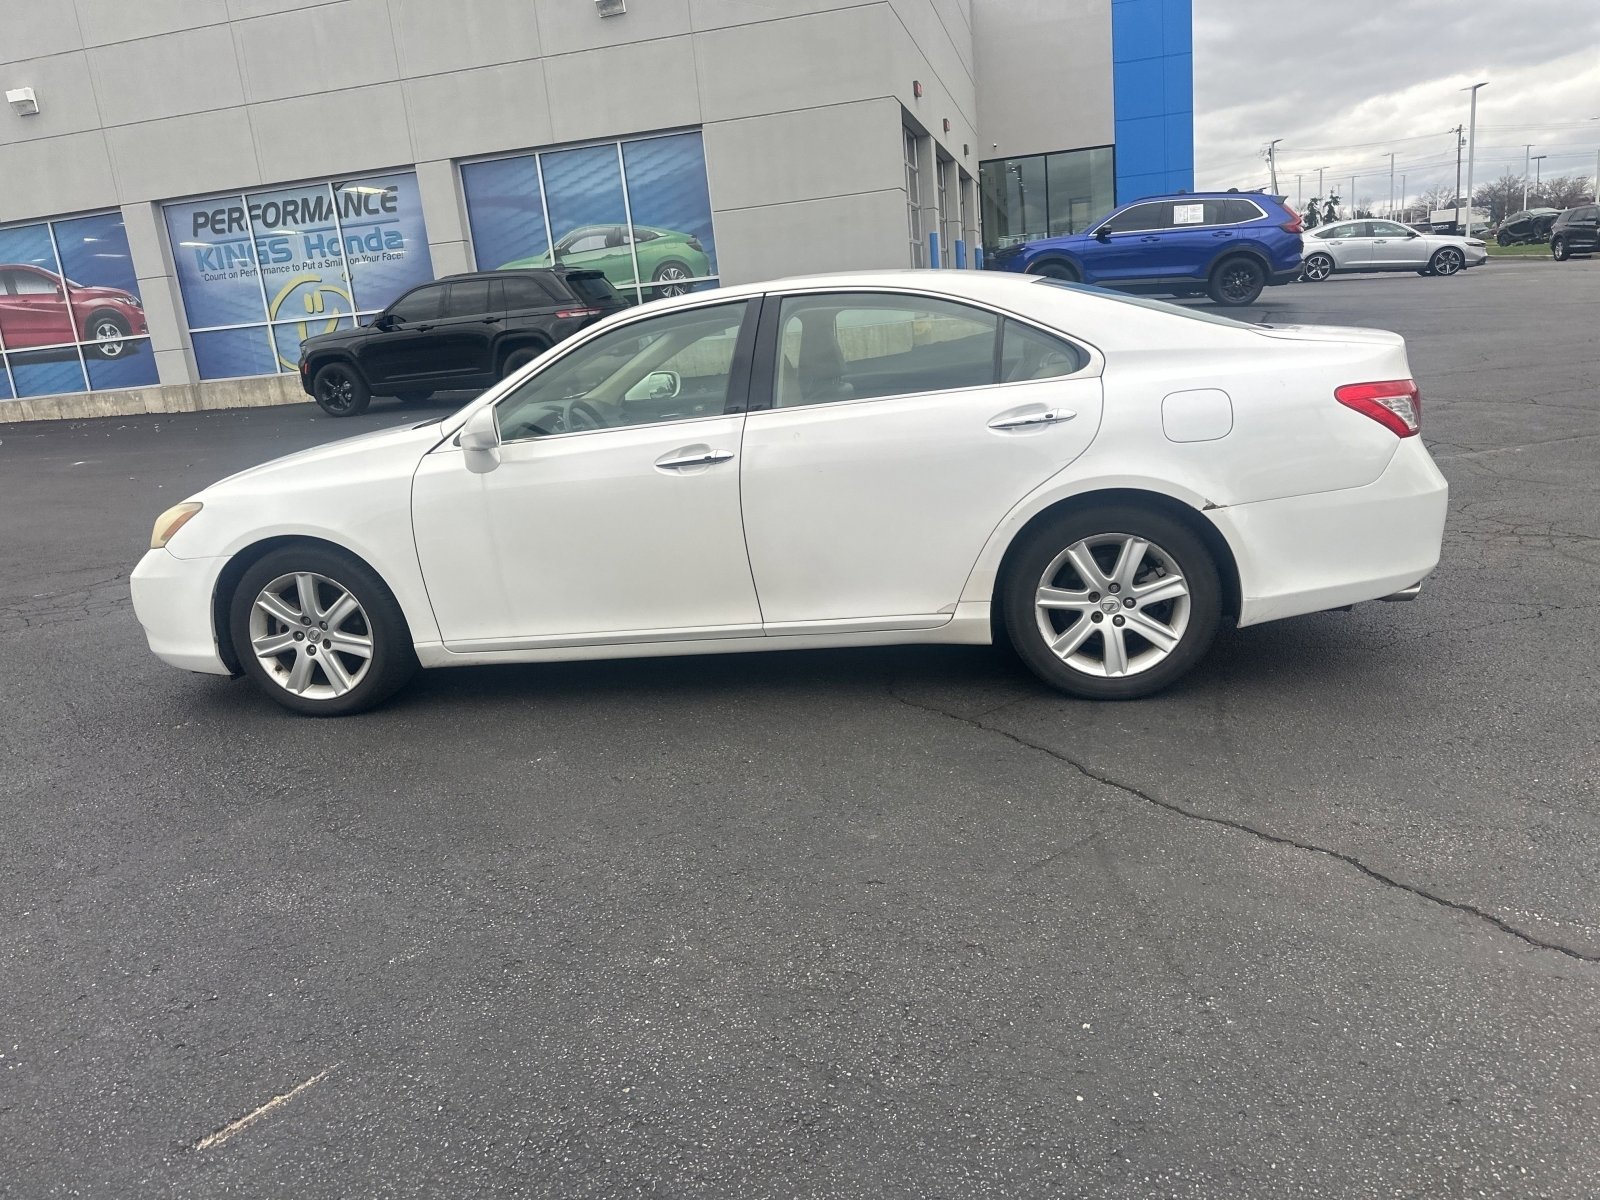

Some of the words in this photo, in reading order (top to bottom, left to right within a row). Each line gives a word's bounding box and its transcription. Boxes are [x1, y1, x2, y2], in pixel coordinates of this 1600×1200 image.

[192, 185, 398, 237] PERFORMANCE
[195, 238, 293, 272] KINGS
[303, 227, 404, 259] Honda
[229, 271, 239, 279] on
[240, 265, 290, 277] Perfmance
[292, 263, 300, 271] to
[302, 261, 316, 270] Put
[325, 257, 346, 267] Smil
[350, 257, 360, 265] on
[361, 254, 379, 263] Your
